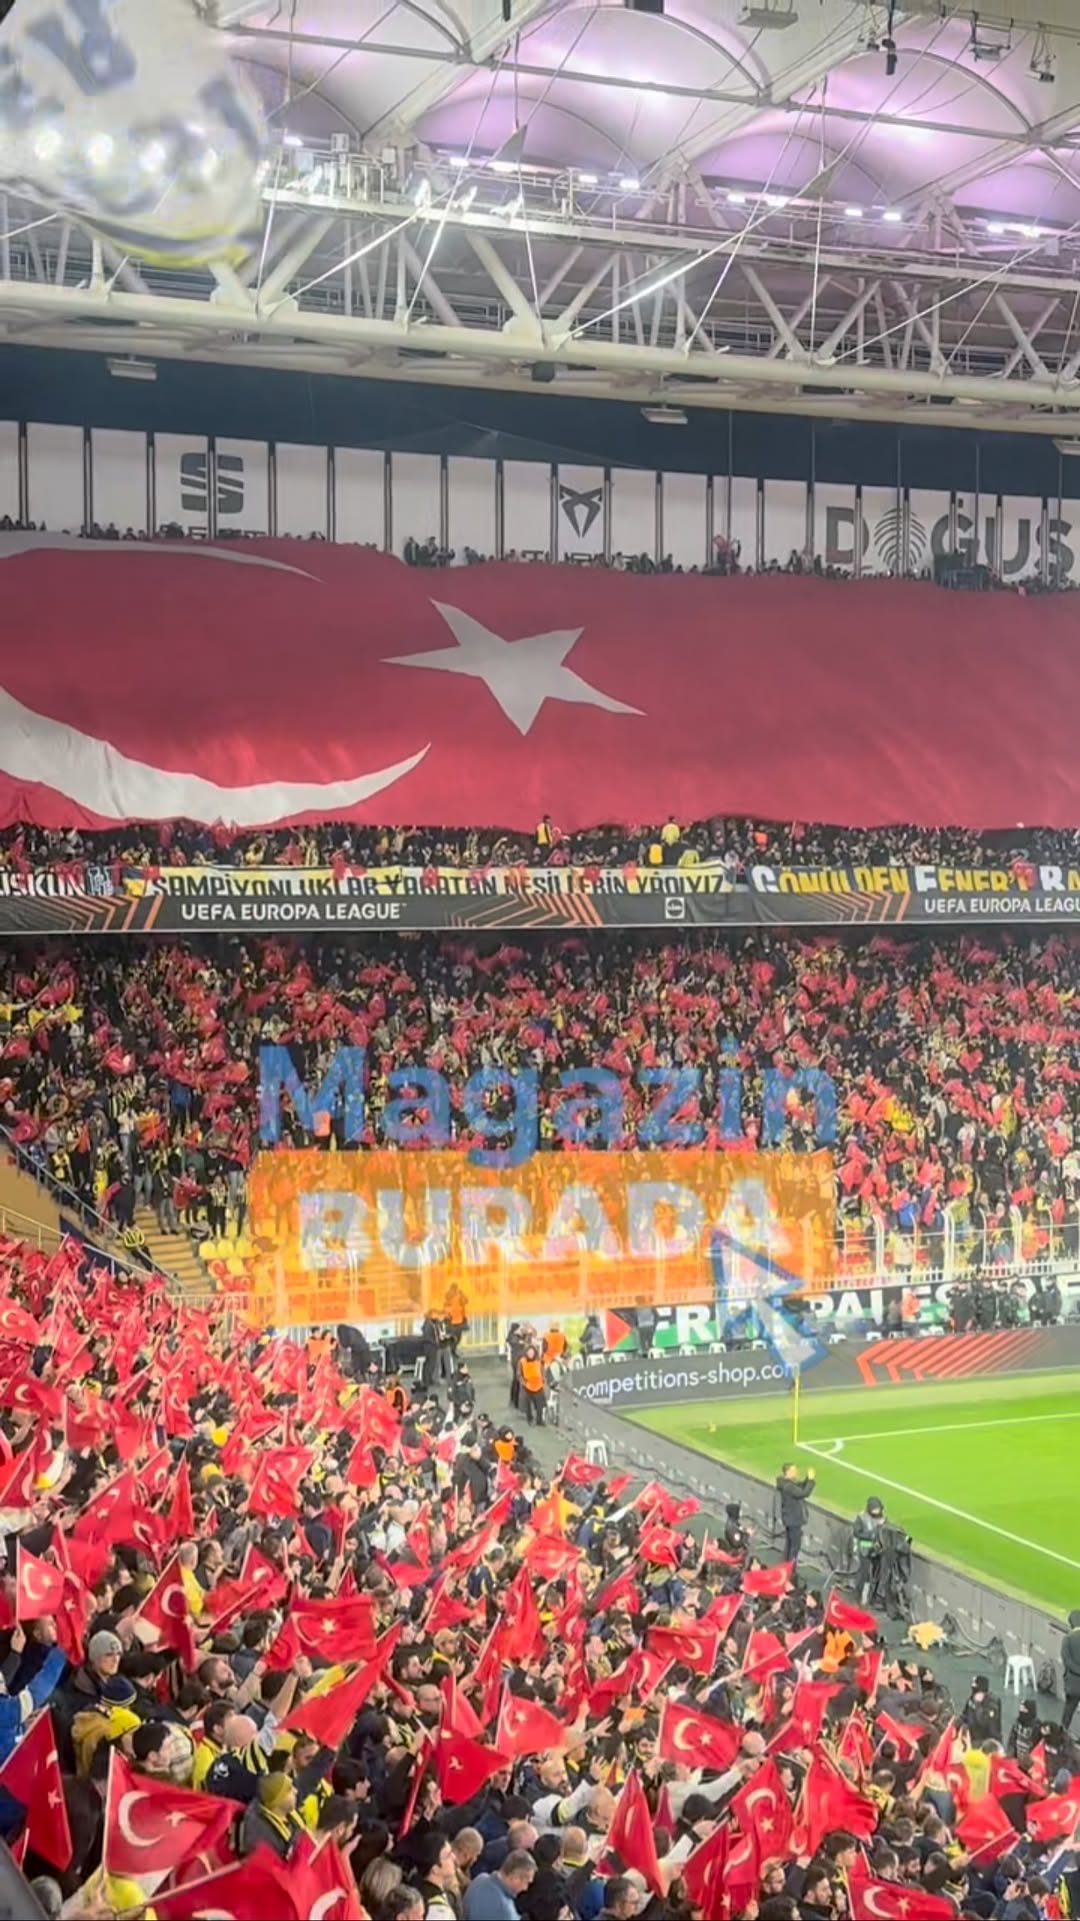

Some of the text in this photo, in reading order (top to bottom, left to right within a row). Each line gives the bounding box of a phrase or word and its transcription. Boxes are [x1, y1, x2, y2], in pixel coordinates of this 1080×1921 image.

[181, 902, 400, 920] UEFA EUROPA LEAGUE
[924, 898, 967, 913] UEFA
[970, 898, 1031, 913] EUROPA
